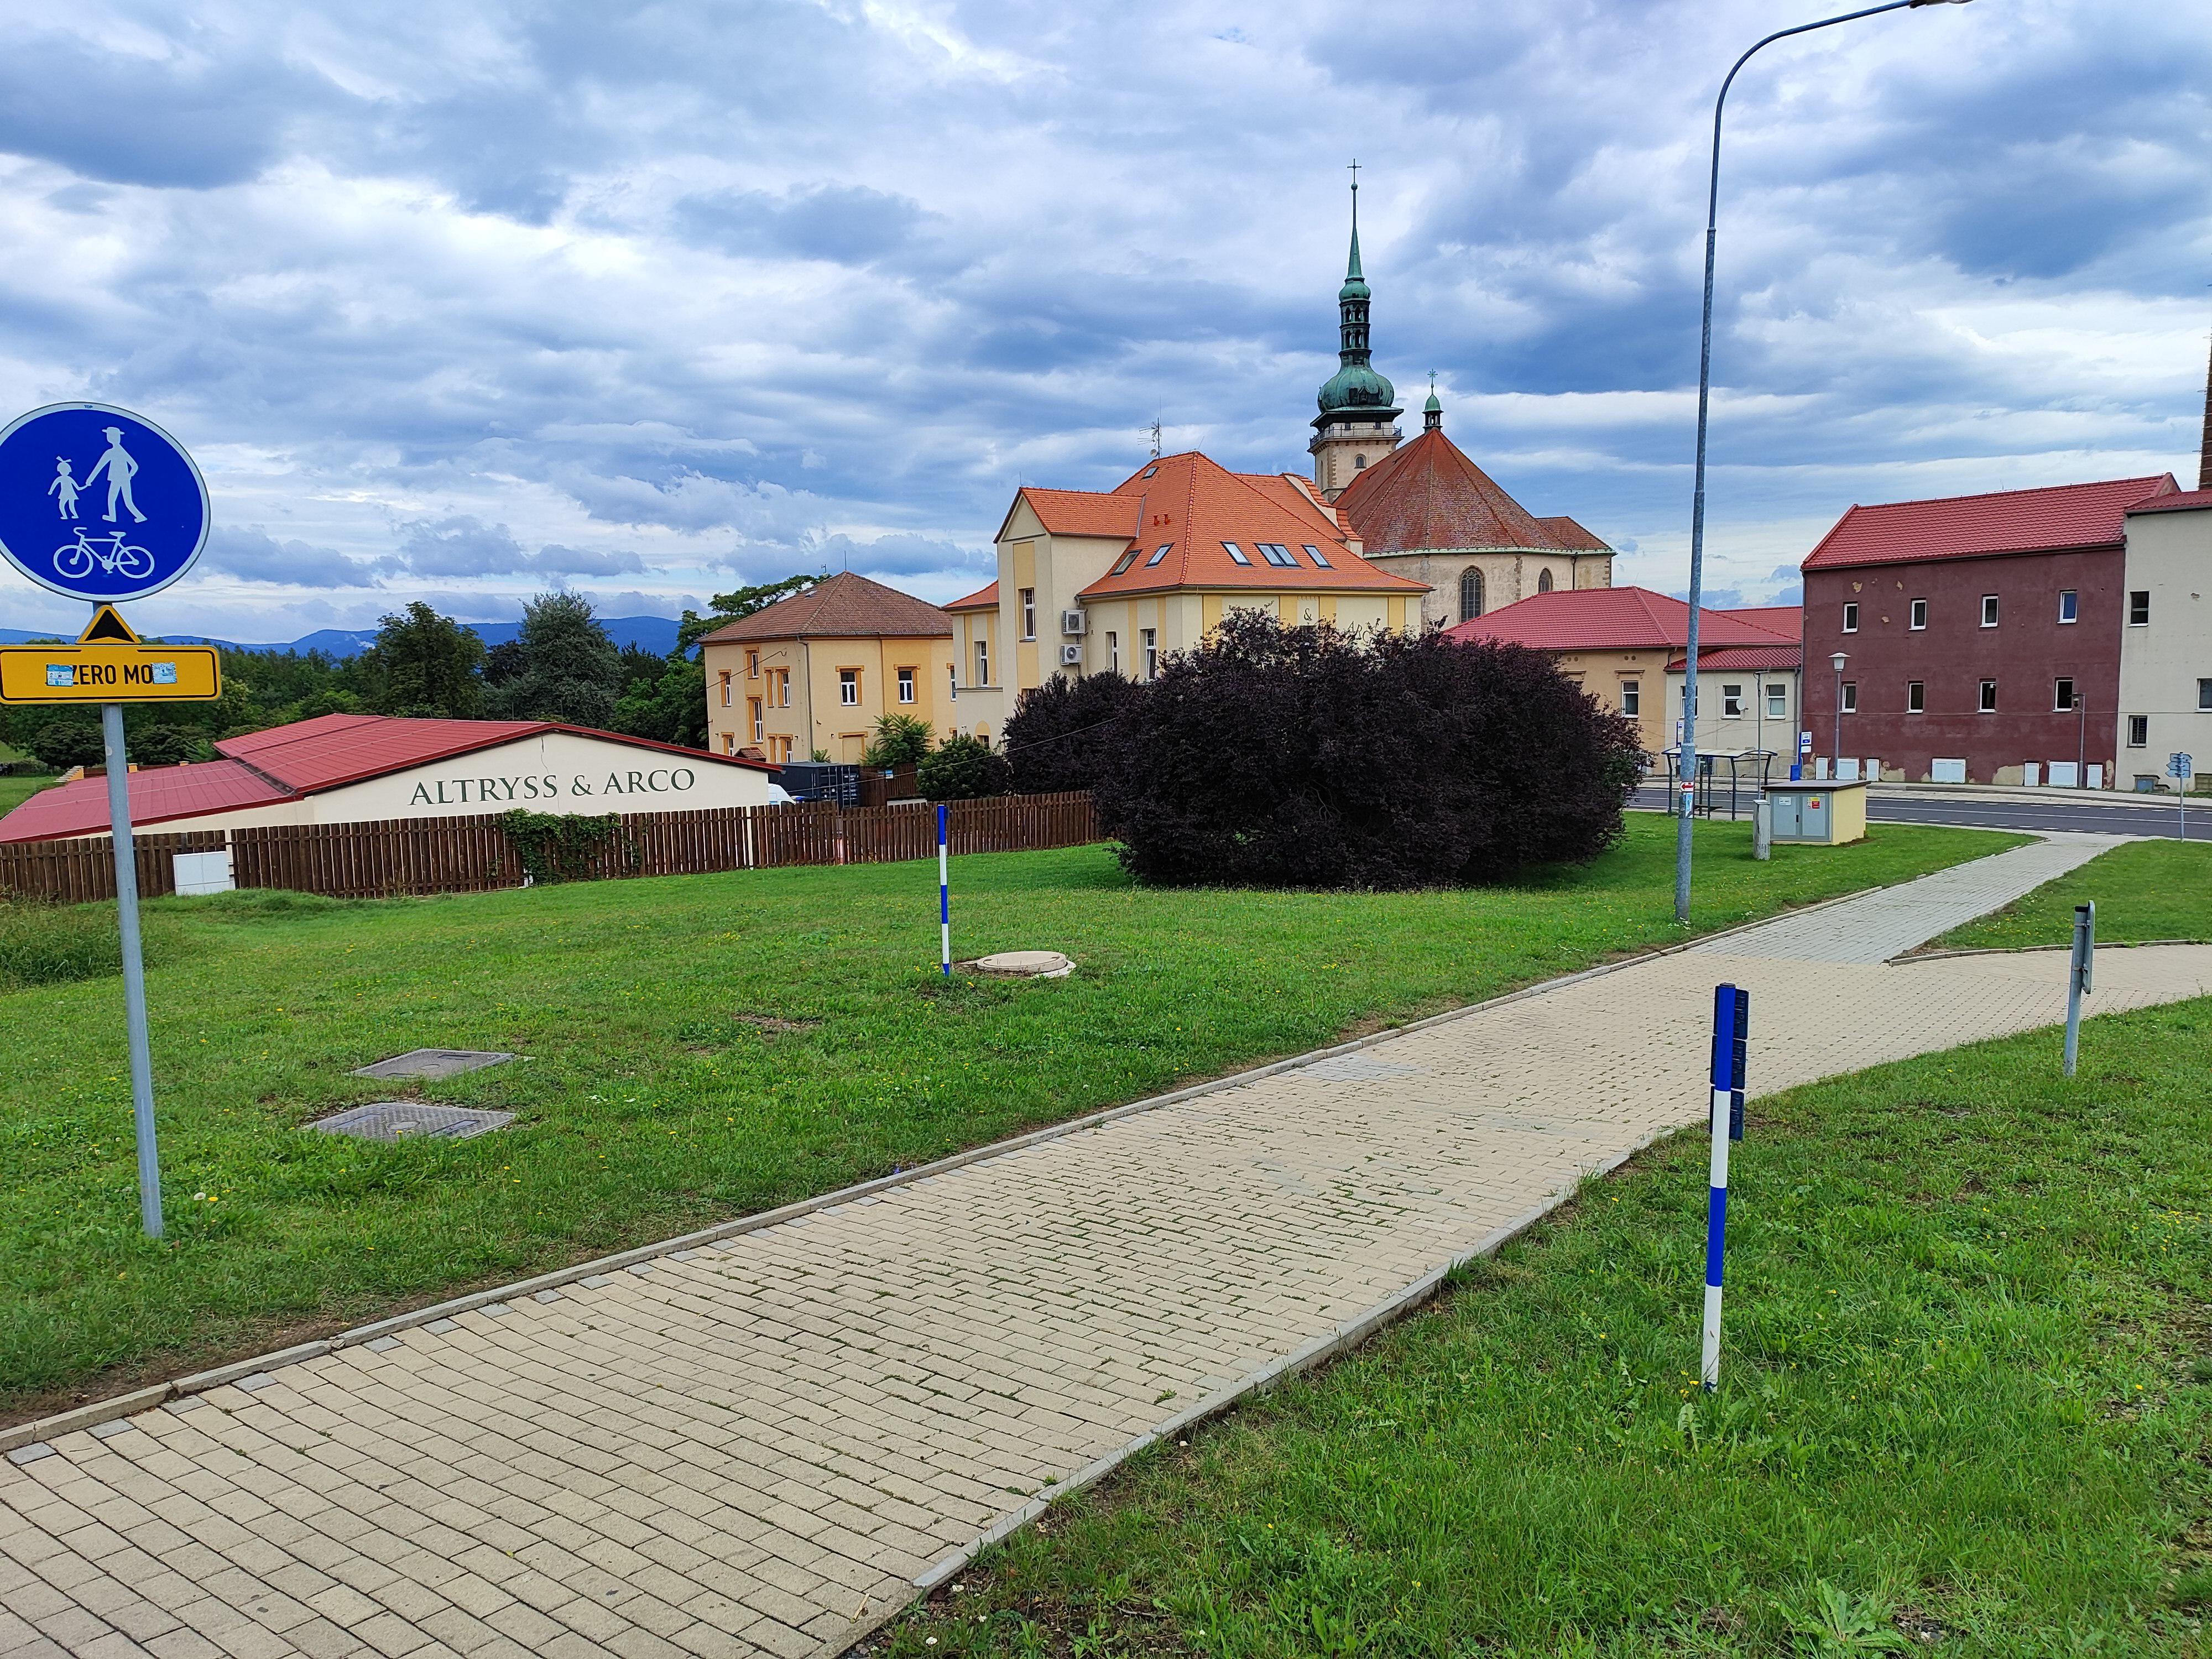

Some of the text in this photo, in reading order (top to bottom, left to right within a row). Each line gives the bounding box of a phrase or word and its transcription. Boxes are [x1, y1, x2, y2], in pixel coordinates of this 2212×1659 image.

[1303, 608, 1313, 621] &
[124, 664, 153, 685] MO
[408, 768, 695, 806] ALTRYSS & ARCO
